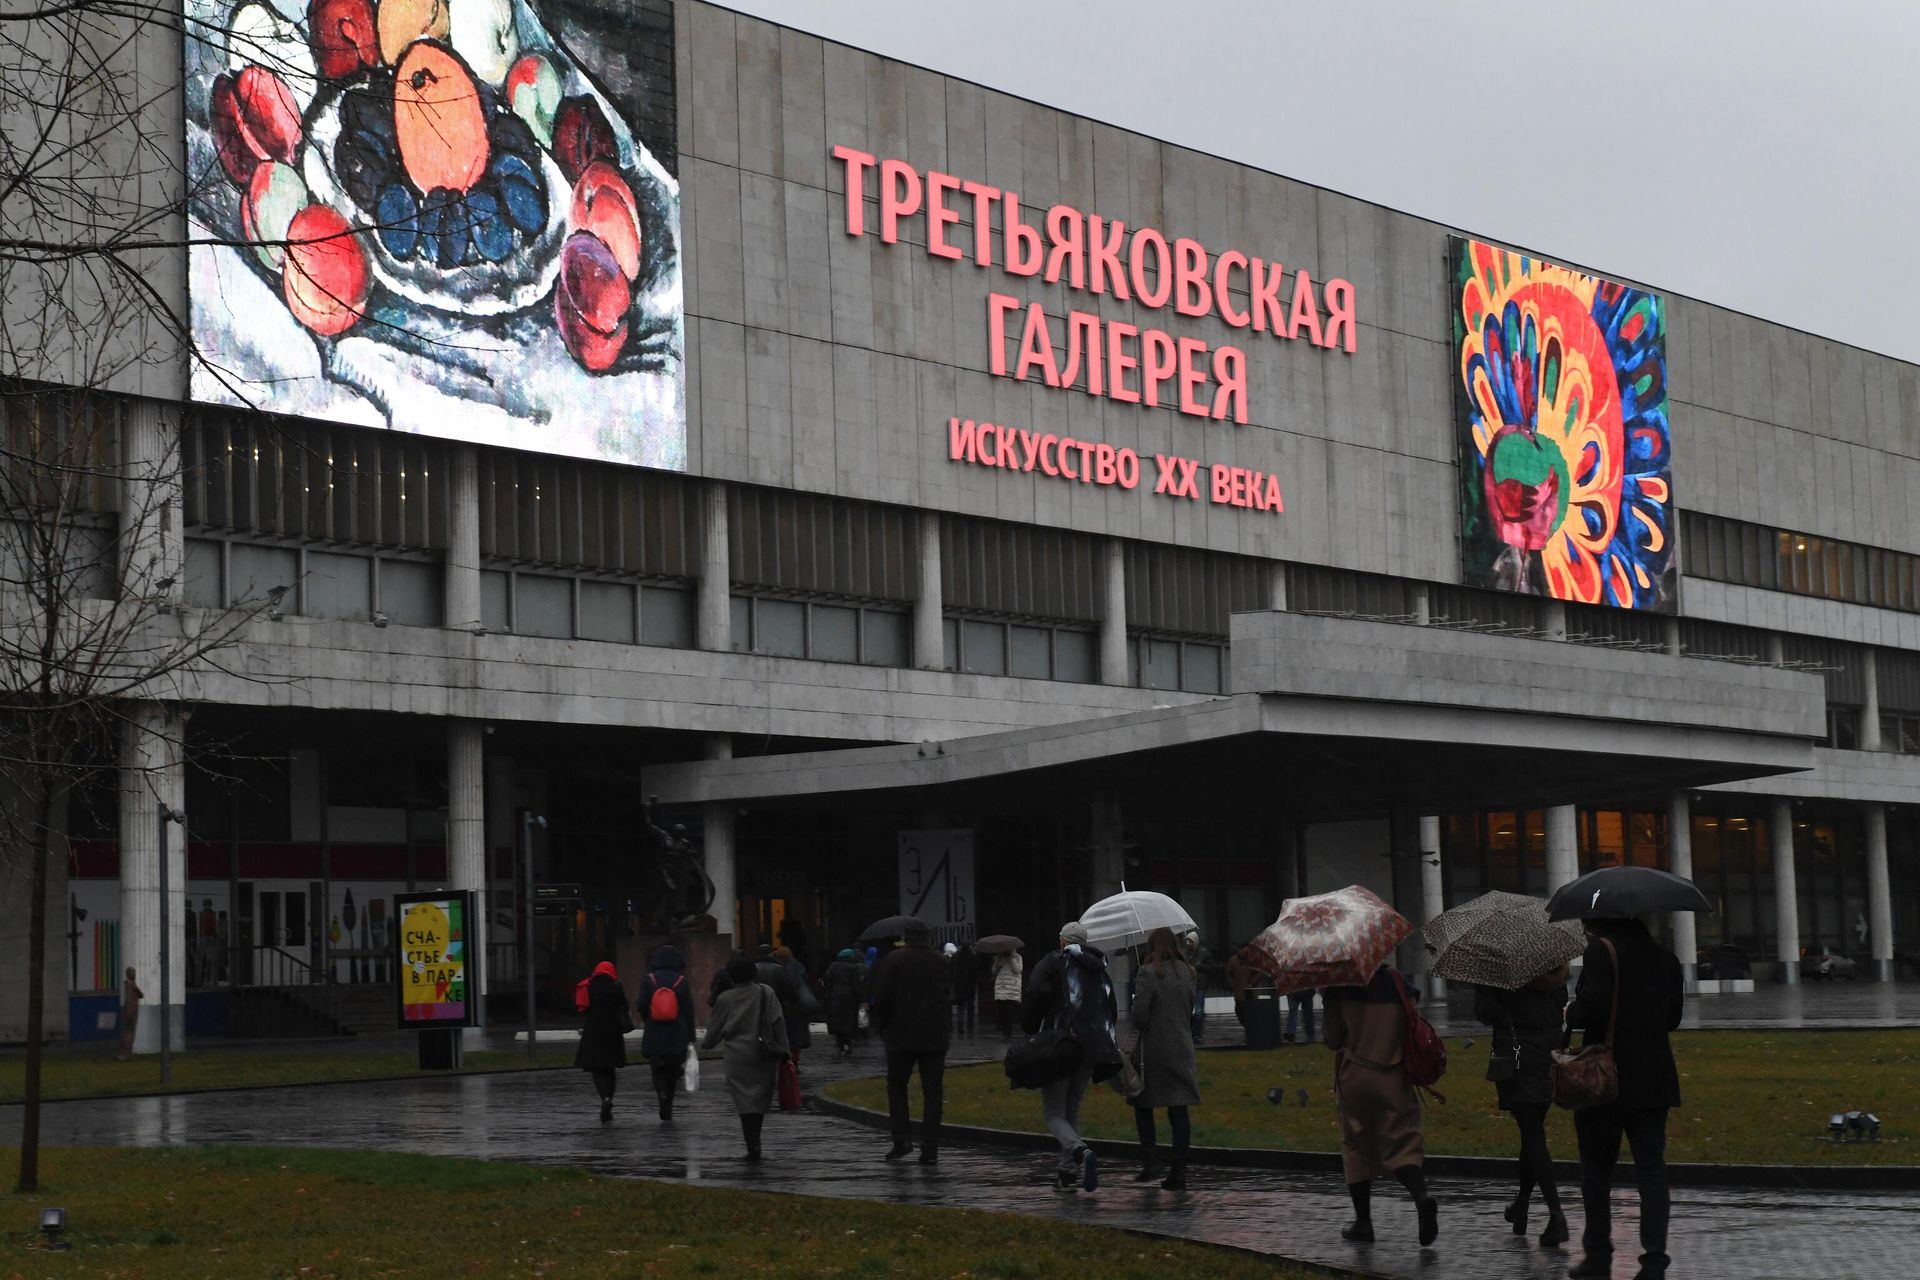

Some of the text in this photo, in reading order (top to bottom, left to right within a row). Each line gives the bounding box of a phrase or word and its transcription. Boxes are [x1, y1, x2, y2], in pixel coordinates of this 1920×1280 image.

[832, 145, 1357, 353] ТРЕТЬЯКОВСКАЯ
[988, 293, 1249, 424] ГАЛЕРЕЯ
[949, 416, 1140, 489] ИСКУССТВО
[1212, 463, 1284, 513] ВЕКА
[406, 930, 442, 945] СЧА-
[407, 950, 440, 965] СТЬЕ
[412, 968, 462, 984] В ПАР-
[445, 989, 462, 1002] КЕ
